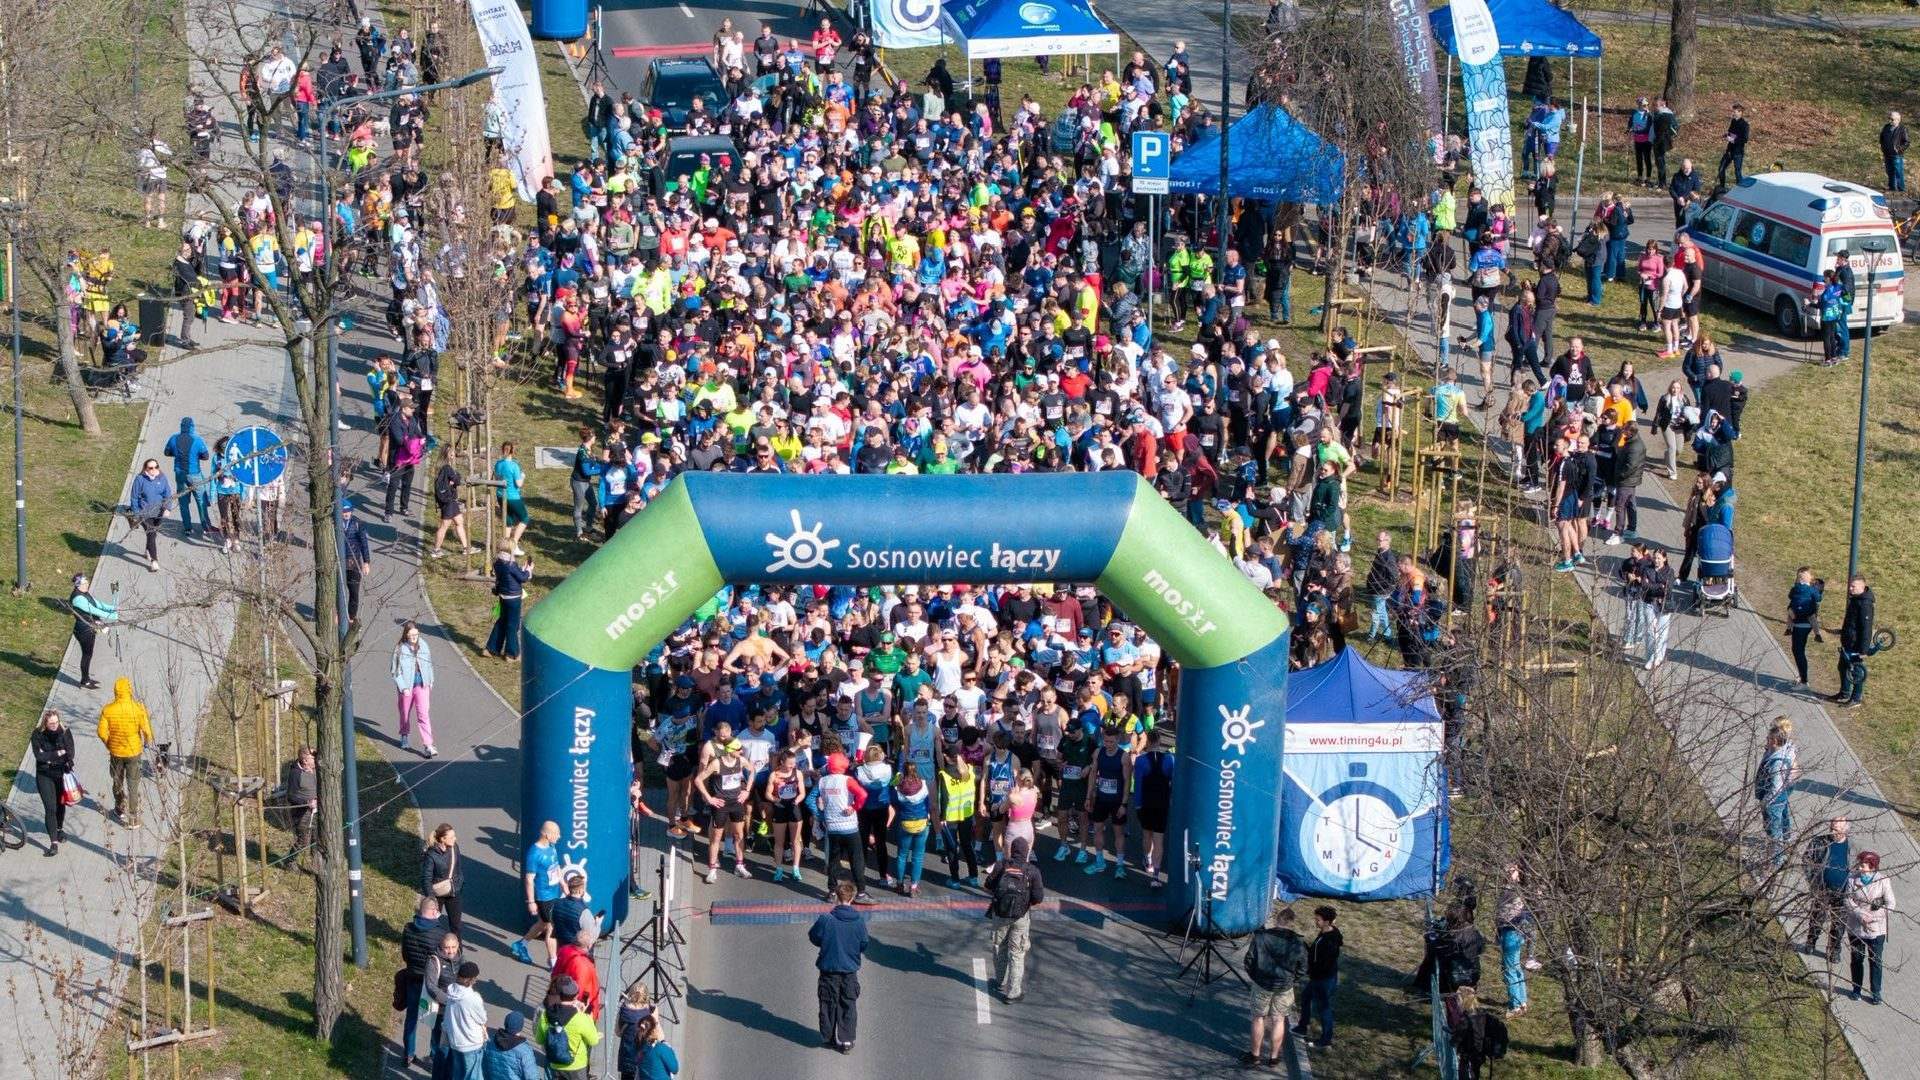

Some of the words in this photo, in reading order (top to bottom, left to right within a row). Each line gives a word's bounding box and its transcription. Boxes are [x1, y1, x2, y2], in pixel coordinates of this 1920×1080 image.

[1141, 136, 1162, 165] P
[848, 544, 982, 570] Sosnowiec
[990, 542, 1061, 573] łączy
[569, 706, 596, 754] łączy
[1309, 735, 1403, 747] www.timing4u.pl
[567, 758, 589, 849] Sosnowiec
[1215, 759, 1241, 849] Sosnowiec
[1208, 854, 1235, 901] łączy
